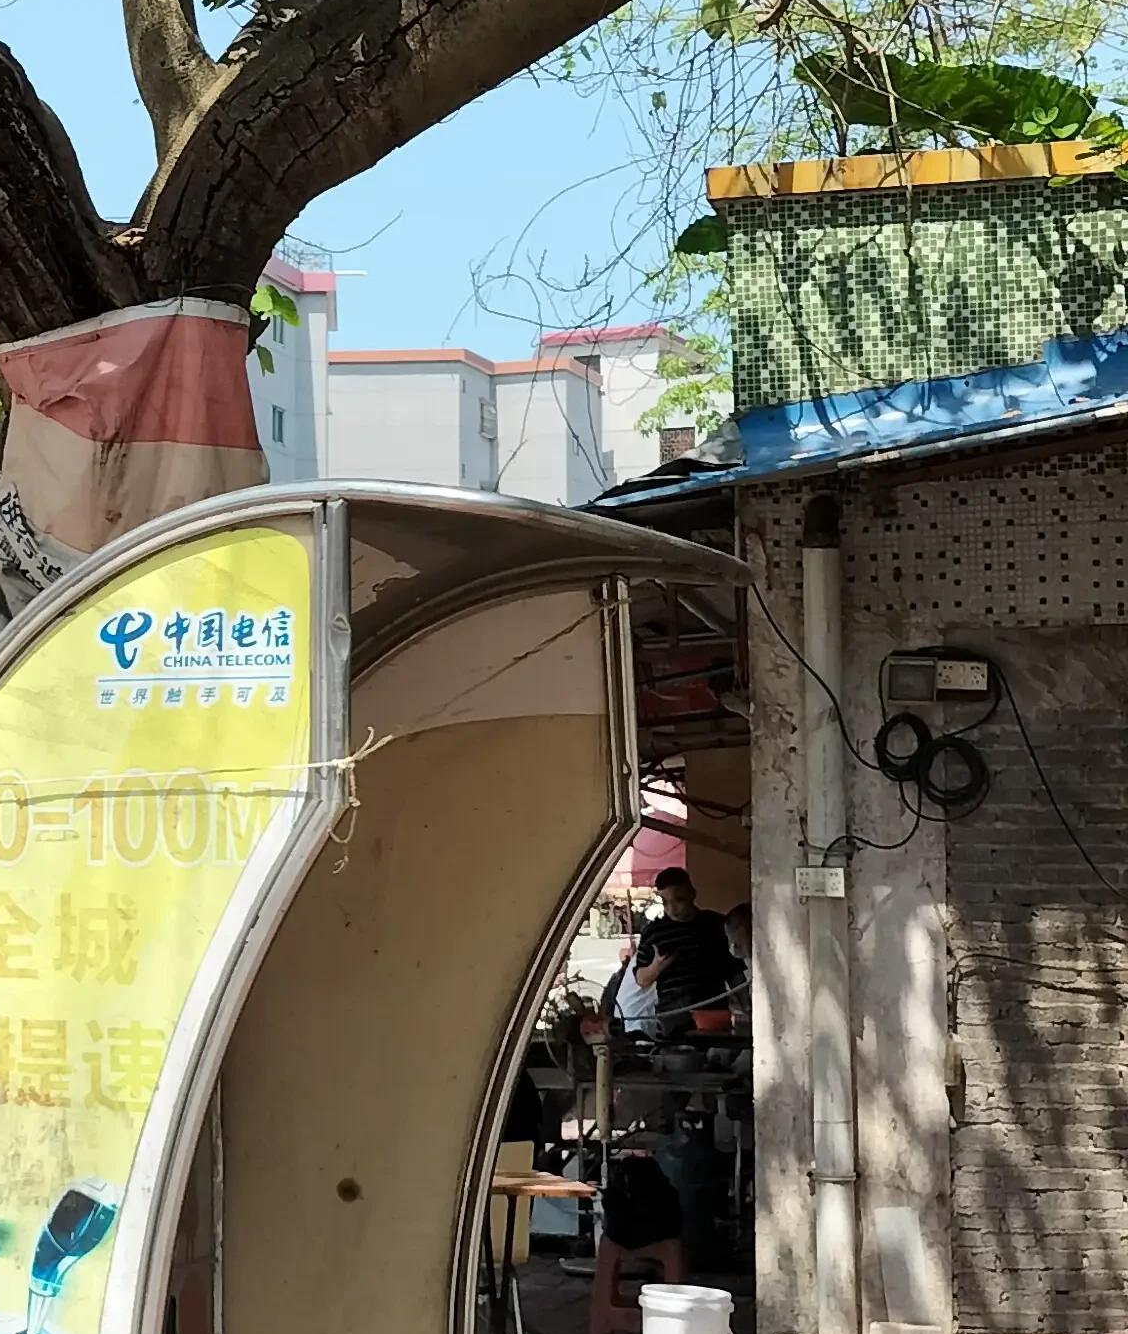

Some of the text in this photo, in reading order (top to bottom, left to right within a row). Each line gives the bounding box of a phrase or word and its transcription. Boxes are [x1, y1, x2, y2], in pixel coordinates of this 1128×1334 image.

[164, 610, 291, 654] 中国电信
[163, 653, 291, 668] CHINA TELECOM
